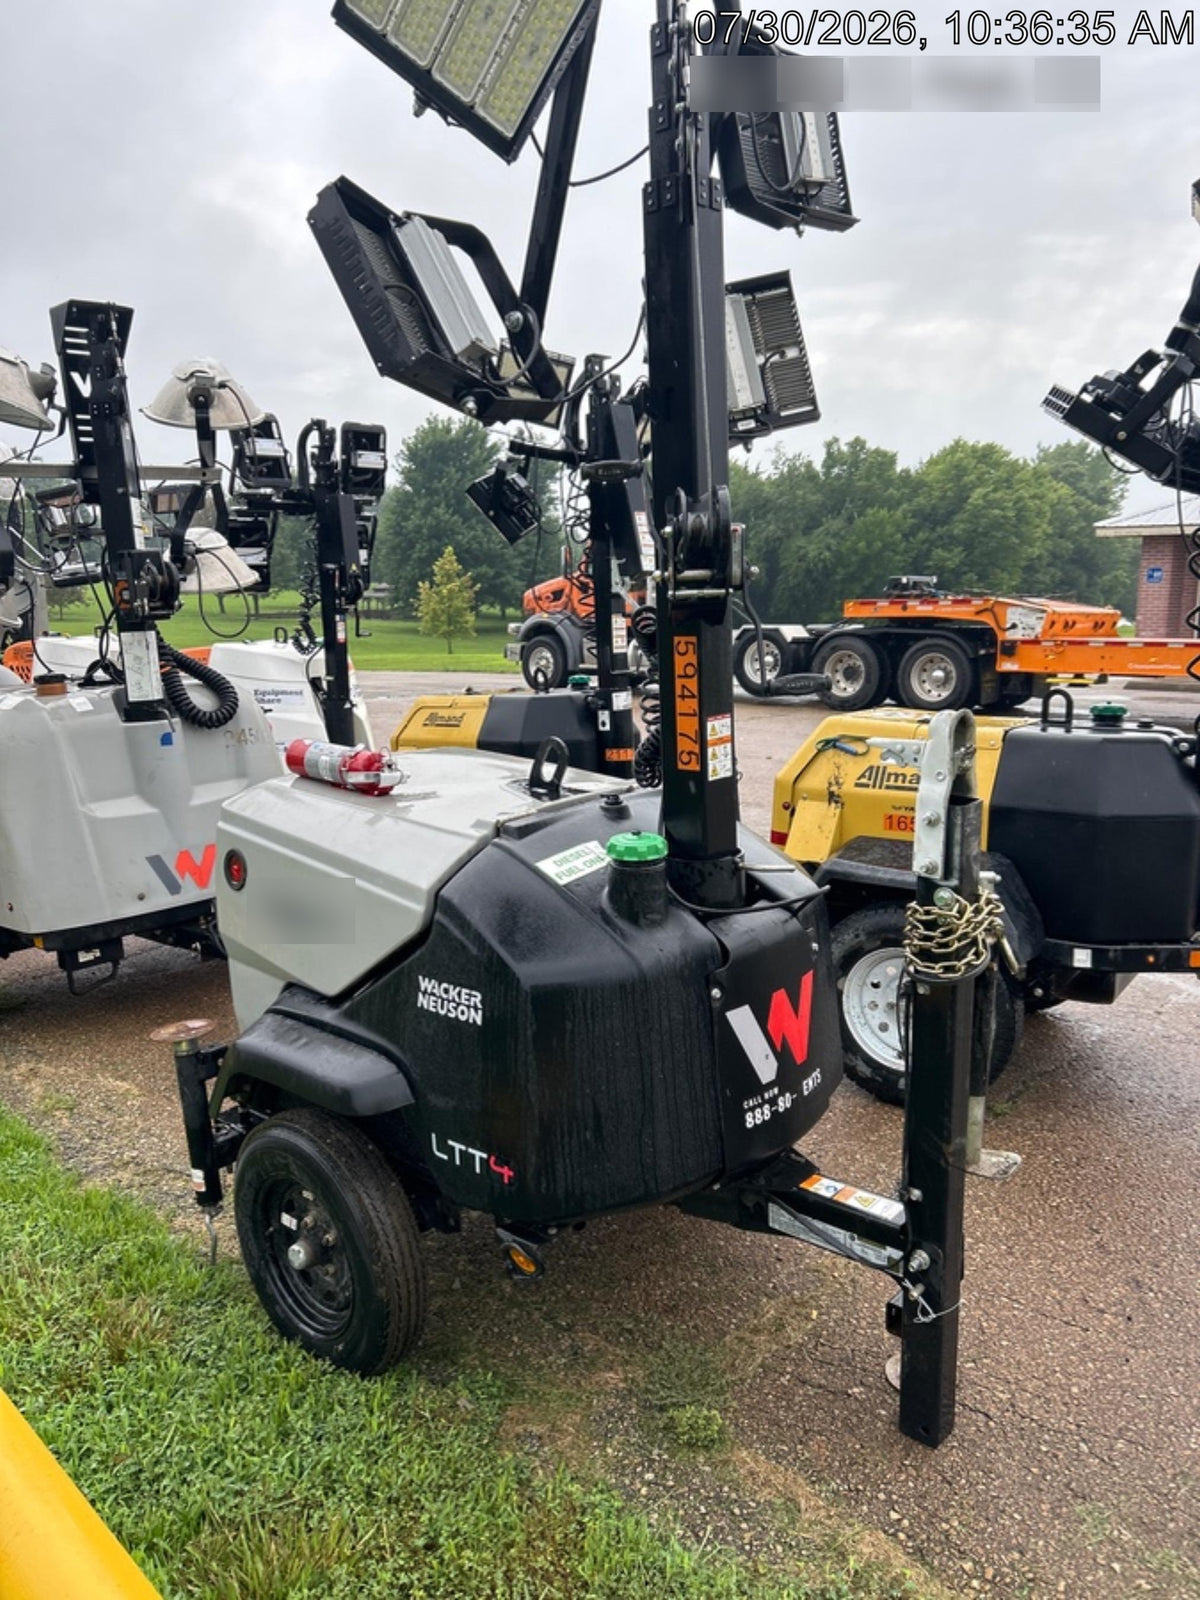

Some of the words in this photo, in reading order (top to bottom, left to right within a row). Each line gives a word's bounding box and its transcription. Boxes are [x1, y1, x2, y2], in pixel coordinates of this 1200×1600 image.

[253, 689, 303, 698] Equipment
[675, 639, 700, 767] 594175
[854, 765, 921, 791] Allma
[553, 848, 590, 867] DIESEL
[554, 865, 584, 880] FUEL
[418, 975, 483, 1009] WACKER
[417, 991, 483, 1026] NEUSON
[743, 1095, 763, 1110] CALL
[764, 1086, 779, 1099] NOW
[431, 1132, 515, 1185] LTT4
